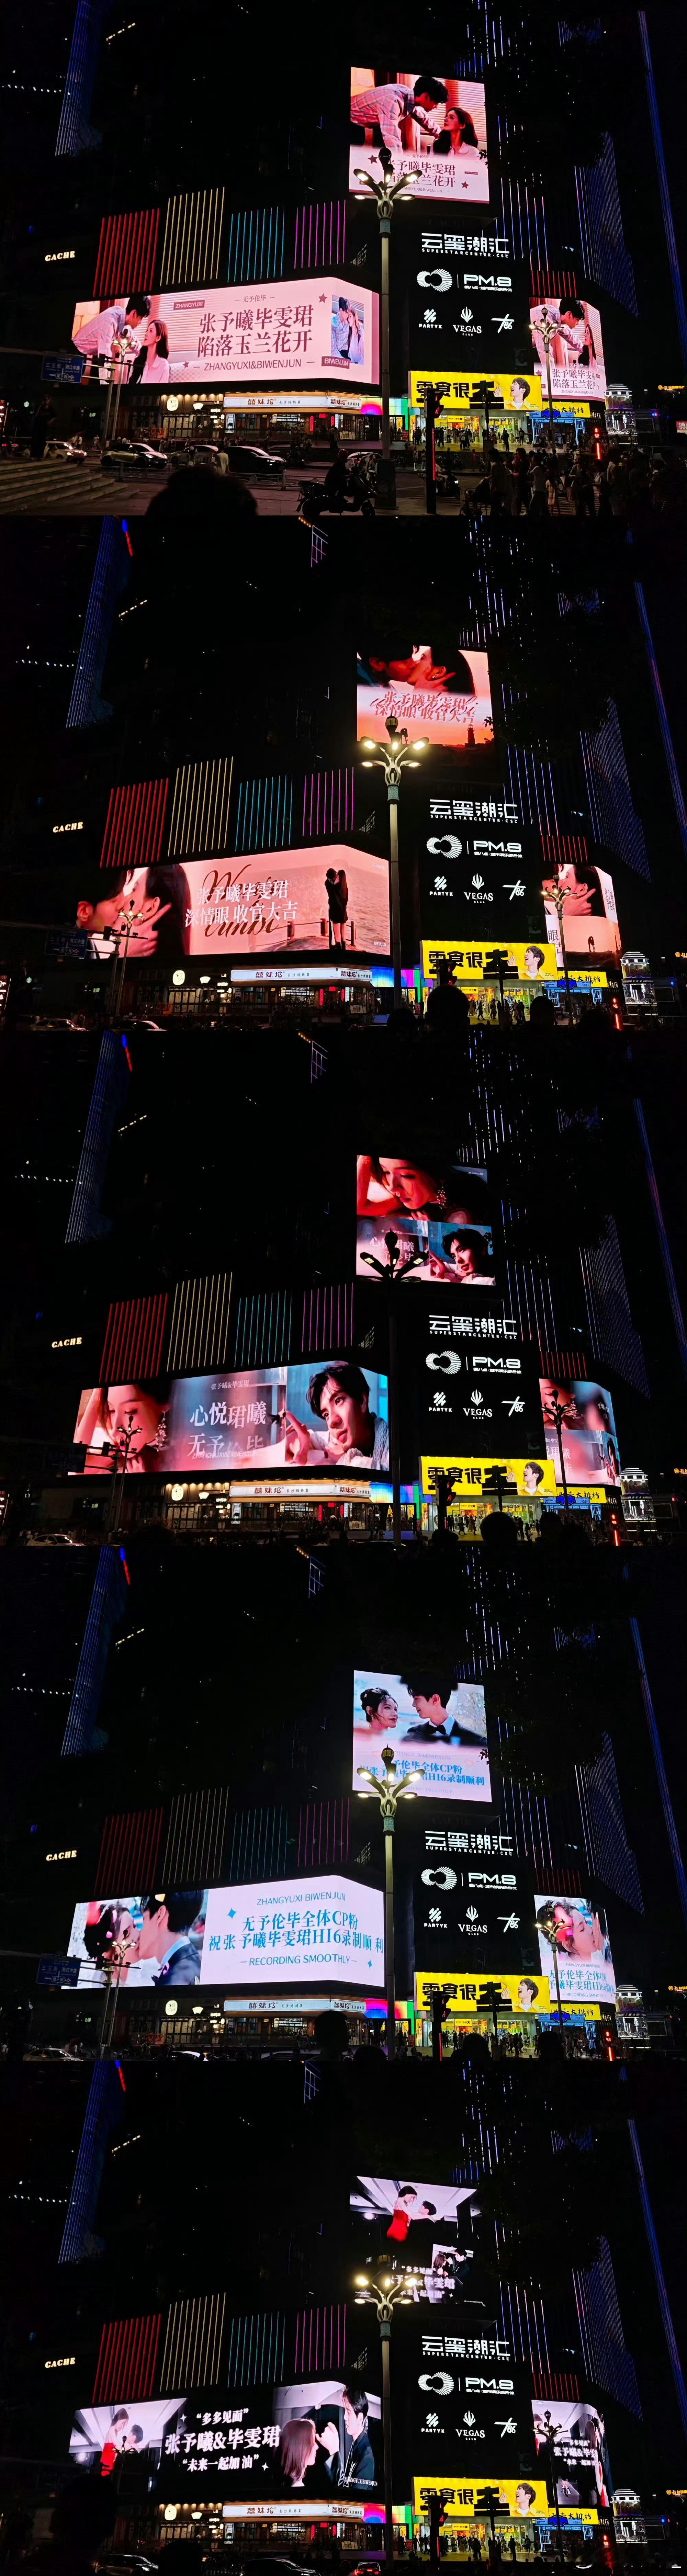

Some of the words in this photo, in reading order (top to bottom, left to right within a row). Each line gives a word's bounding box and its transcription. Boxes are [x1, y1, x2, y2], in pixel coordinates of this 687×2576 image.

[421, 233, 510, 253] 云玺潮汇
[45, 251, 75, 261] CACHE
[464, 274, 511, 287] PM.8
[243, 294, 267, 303] 无予伦毕
[200, 304, 313, 334] 张予曦毕雯珺
[453, 325, 482, 334] VEGAS
[198, 329, 313, 358] 陷落玉兰花开
[204, 359, 301, 371] ZHANGYUXI&BIWENJUN
[324, 358, 348, 367] BIWENJUN
[552, 369, 595, 380] 张予曦毕雯珺
[553, 379, 595, 390] 陷落玉兰花开
[430, 799, 518, 819] 云玺潮汇
[53, 822, 83, 833] CACHE
[473, 840, 521, 852] PM.8
[197, 879, 289, 905] 张予曦毕雯珺
[464, 892, 493, 901] VEGAS
[548, 930, 559, 941] 眼
[429, 1315, 518, 1335] 云玺潮汇
[52, 1337, 82, 1348] CACHE
[472, 1356, 521, 1368] PM.8
[211, 1380, 250, 1390] 张予曦&毕雯珺
[190, 1401, 267, 1429] 心悦珺曦
[463, 1408, 492, 1417] VEGAS
[382, 1760, 462, 1774] 予伦毕全体CP粉
[425, 1831, 513, 1851] 云玺潮汇
[46, 1850, 77, 1861] CACHE
[468, 1872, 516, 1885] PM.8
[257, 1895, 302, 1906] ZHANGYUXI
[305, 1891, 345, 1901] BIWENJUN
[242, 1909, 358, 1932] 无予伦毕全体CP粉
[458, 1924, 487, 1933] VEGAS
[249, 1955, 301, 1966] RECORDING
[303, 1954, 350, 1964] SMOOTHLY
[422, 2336, 510, 2356] 云玺潮汇
[45, 2357, 75, 2368] CACHE
[465, 2377, 514, 2390] PM.8
[165, 2425, 281, 2454] 张予曦&毕雯珺
[455, 2429, 485, 2438] VEGAS
